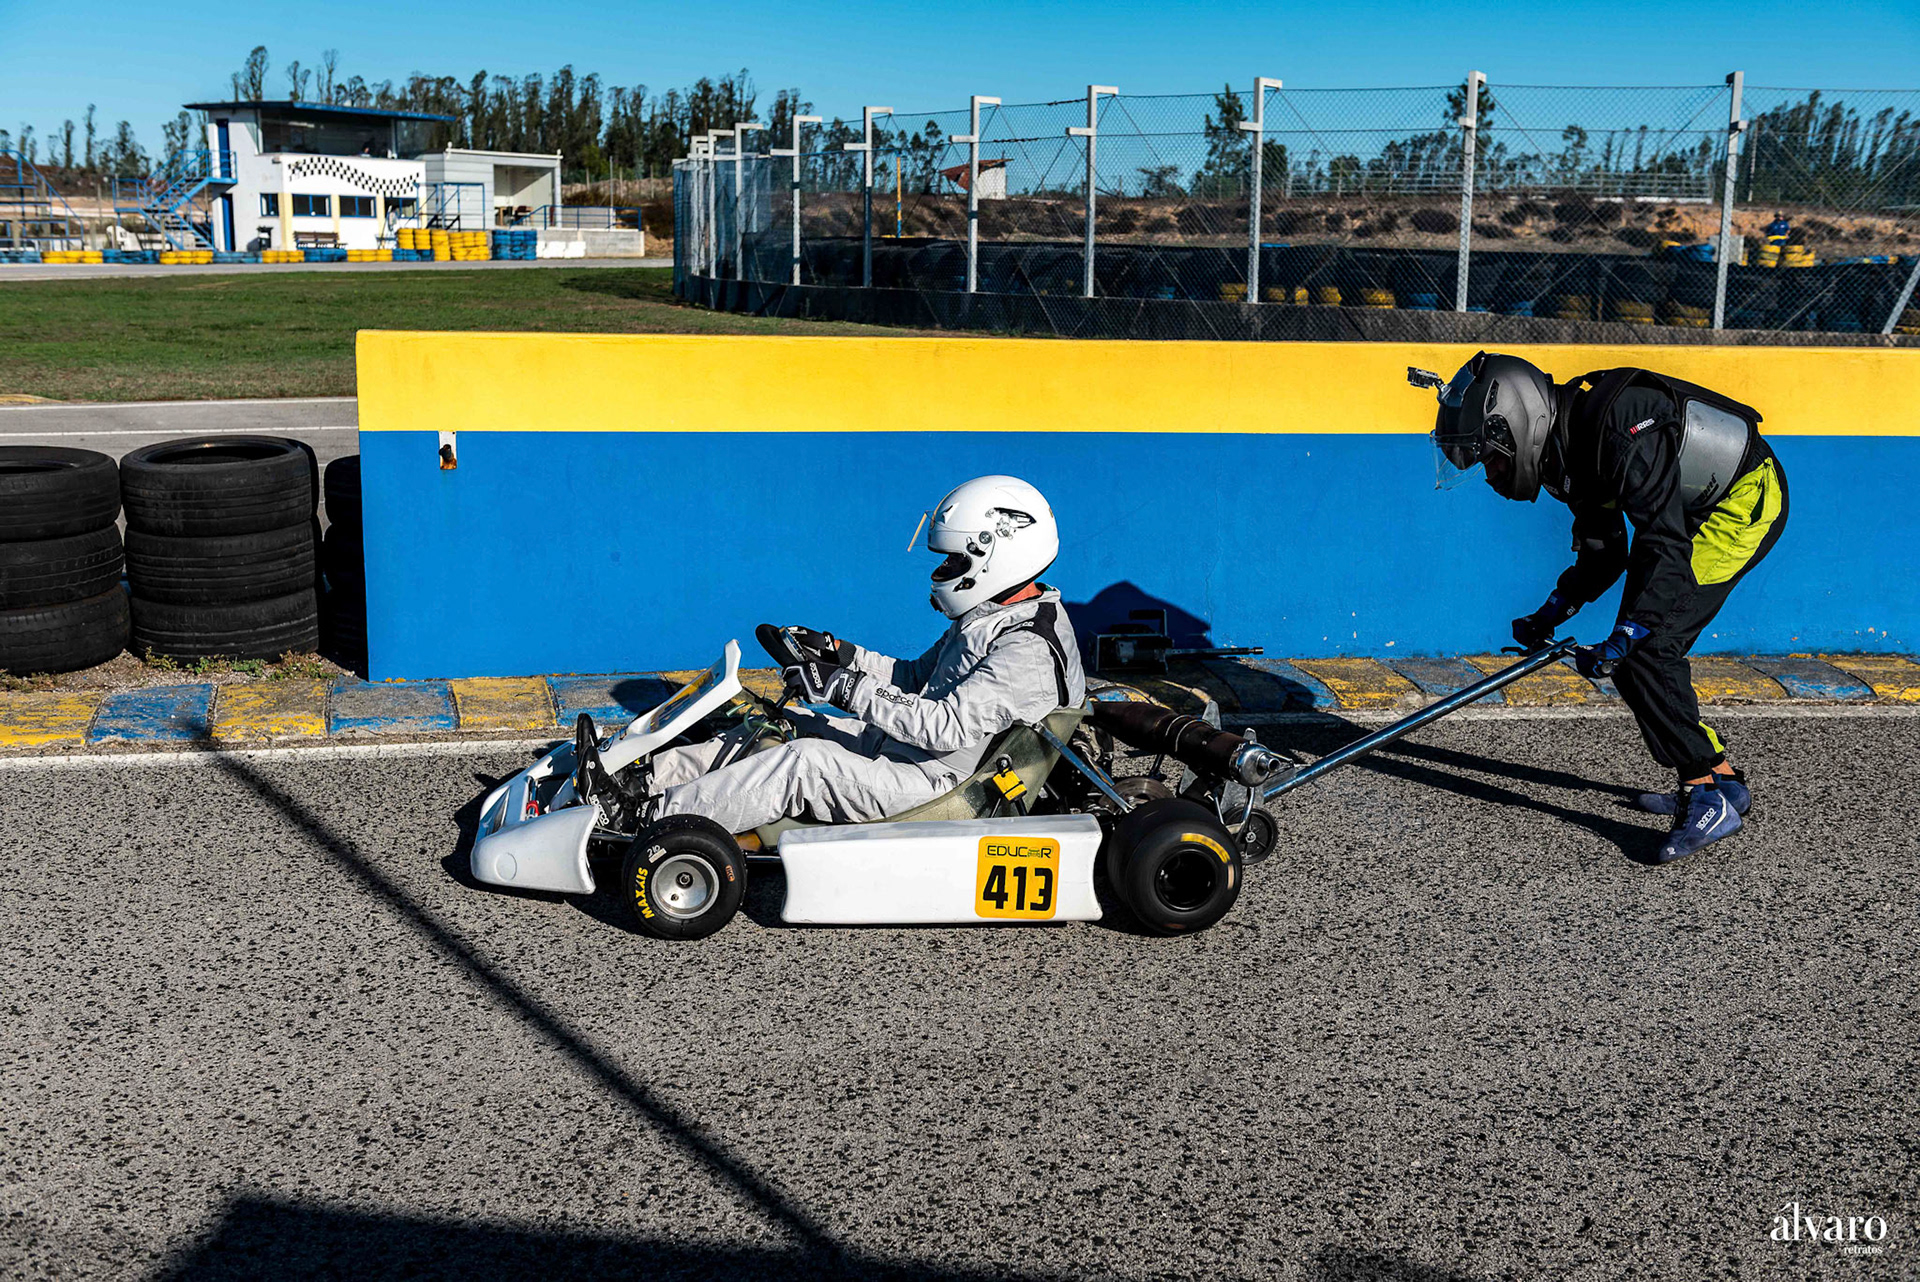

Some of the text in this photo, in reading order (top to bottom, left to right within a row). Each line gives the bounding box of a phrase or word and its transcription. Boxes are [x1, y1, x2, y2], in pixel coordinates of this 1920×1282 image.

[875, 687, 914, 707] sparco
[1695, 807, 1717, 830] sparco
[635, 867, 655, 919] MAXXIS
[982, 865, 1053, 911] 413
